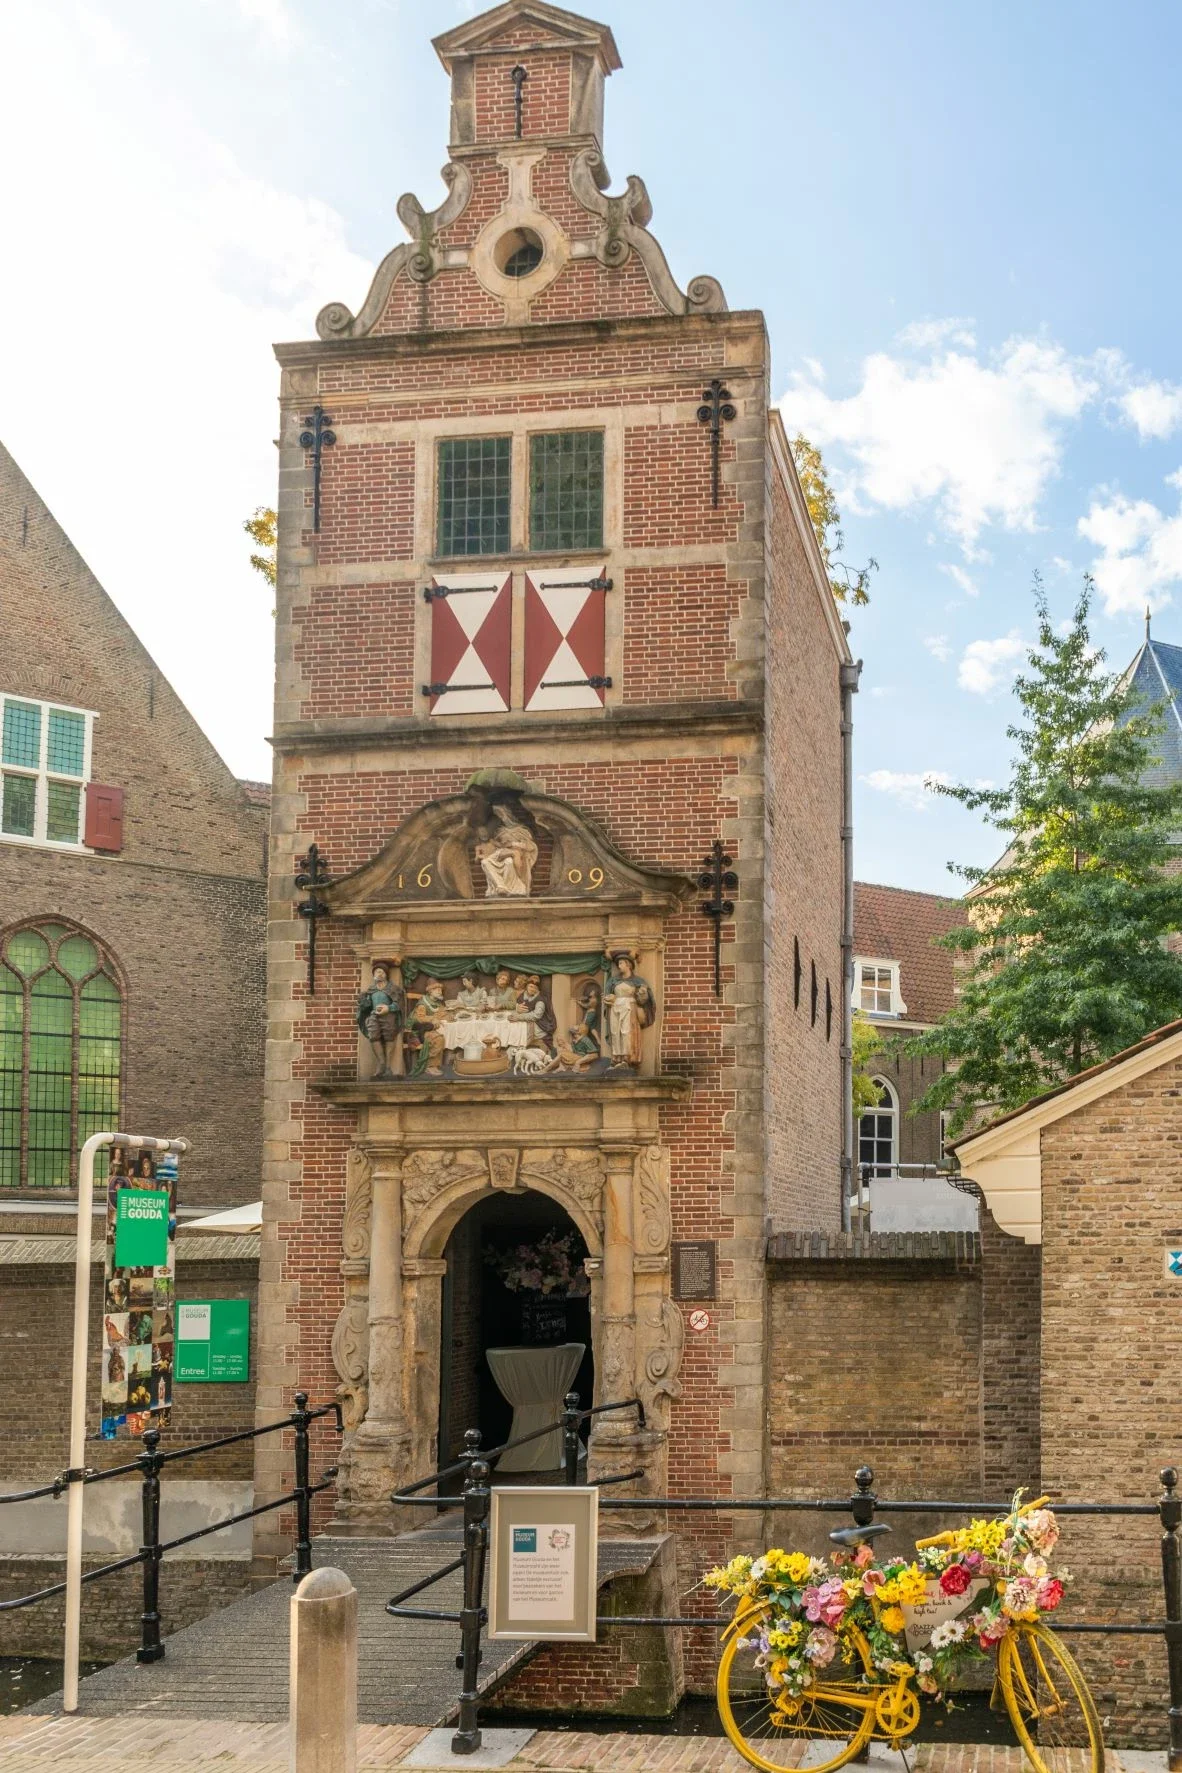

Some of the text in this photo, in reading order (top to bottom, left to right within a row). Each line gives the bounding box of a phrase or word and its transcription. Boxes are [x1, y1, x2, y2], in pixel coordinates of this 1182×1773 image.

[128, 1197, 166, 1208] MUSEUM
[128, 1208, 163, 1220] GOUDA
[181, 1367, 206, 1375] Entree
